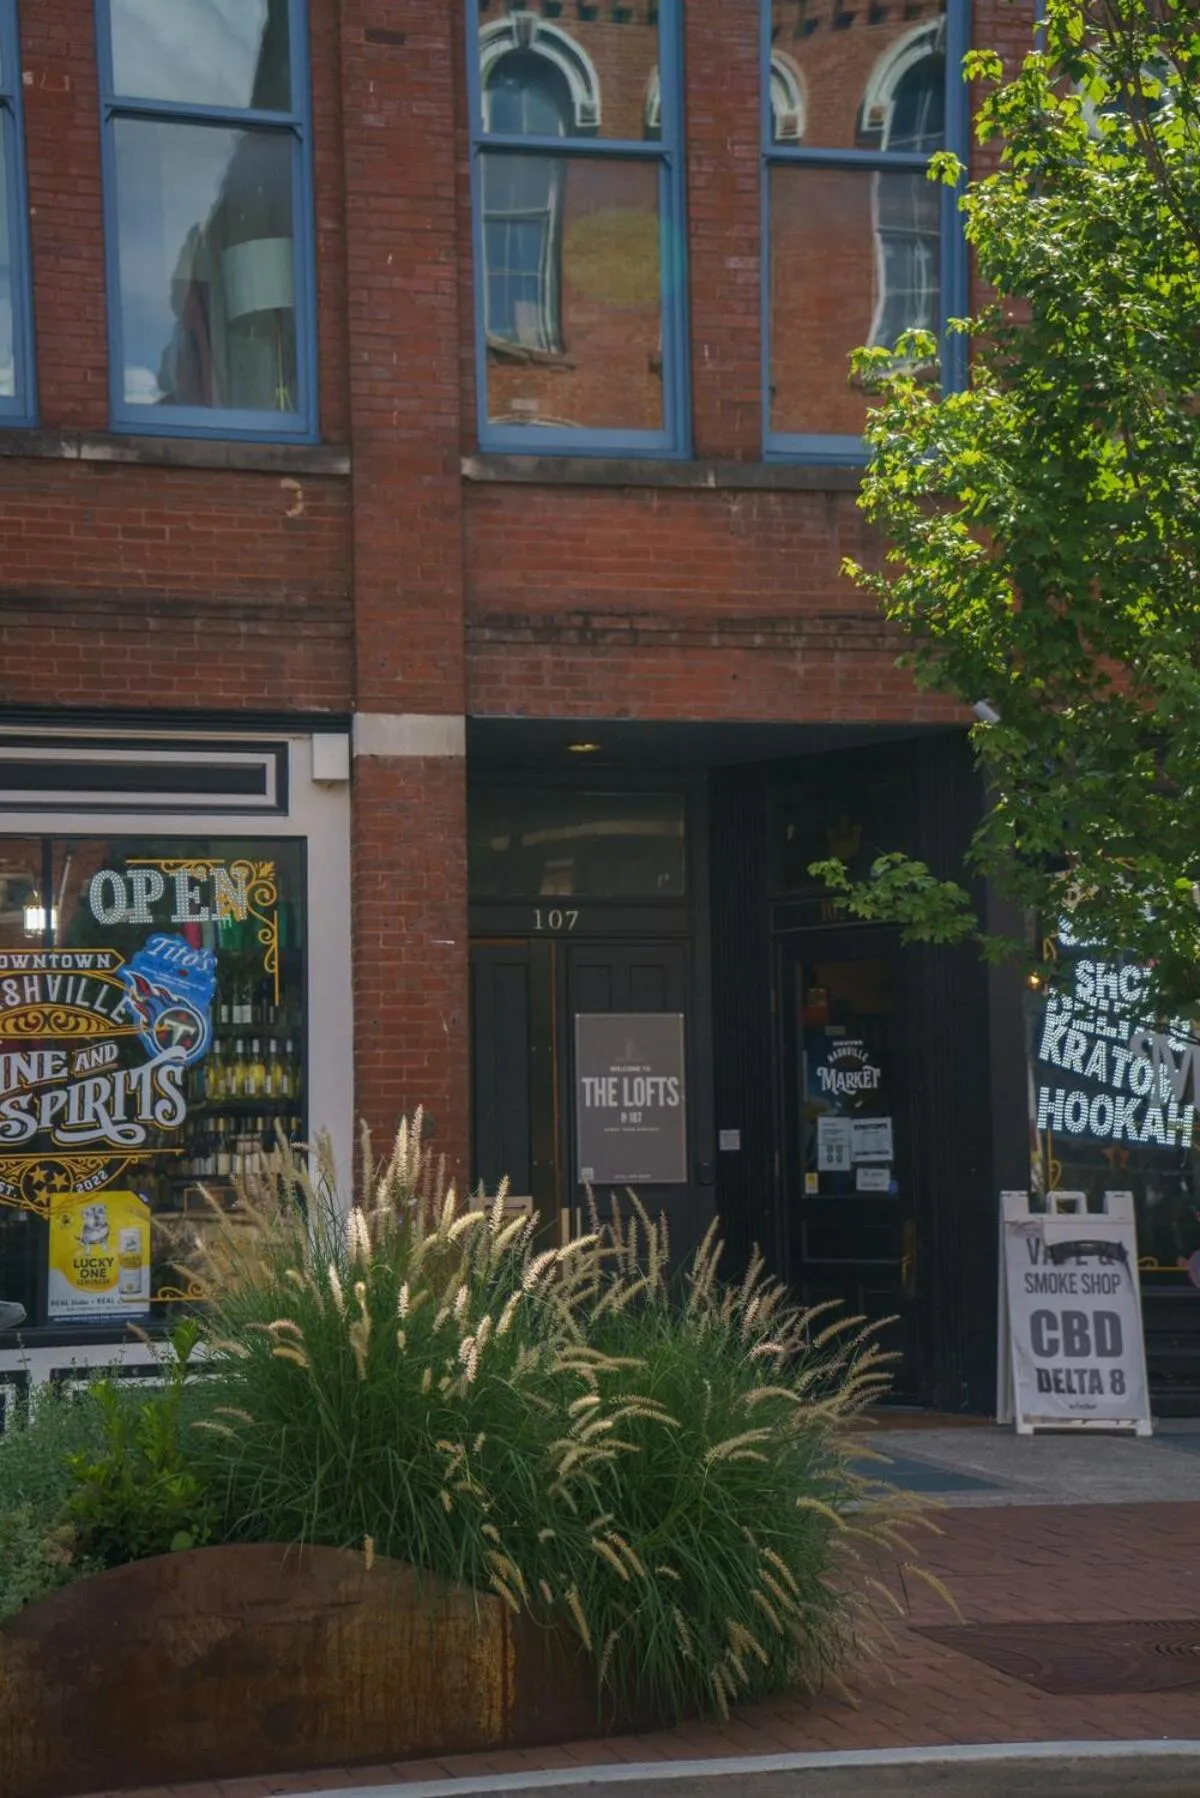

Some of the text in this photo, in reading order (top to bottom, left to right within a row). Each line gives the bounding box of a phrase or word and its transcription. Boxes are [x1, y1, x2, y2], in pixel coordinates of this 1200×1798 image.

[89, 867, 249, 925] OPEN
[533, 909, 580, 931] 107
[147, 937, 213, 972] Tito's
[0, 974, 130, 1025] SHVILLE
[74, 1041, 119, 1072] AND
[0, 1046, 187, 1144] SPIRITS
[581, 1077, 680, 1107] THE LOFTS
[817, 1065, 880, 1095] MARKET
[1037, 1086, 1195, 1148] HOOKAH
[76, 1170, 109, 1192] 2022
[73, 1258, 114, 1268] LUCKY
[80, 1269, 107, 1278] ONE
[1025, 1273, 1121, 1295] SMOKE SHOP
[1030, 1309, 1123, 1358] CBD
[1036, 1367, 1126, 1396] DELTA 8
